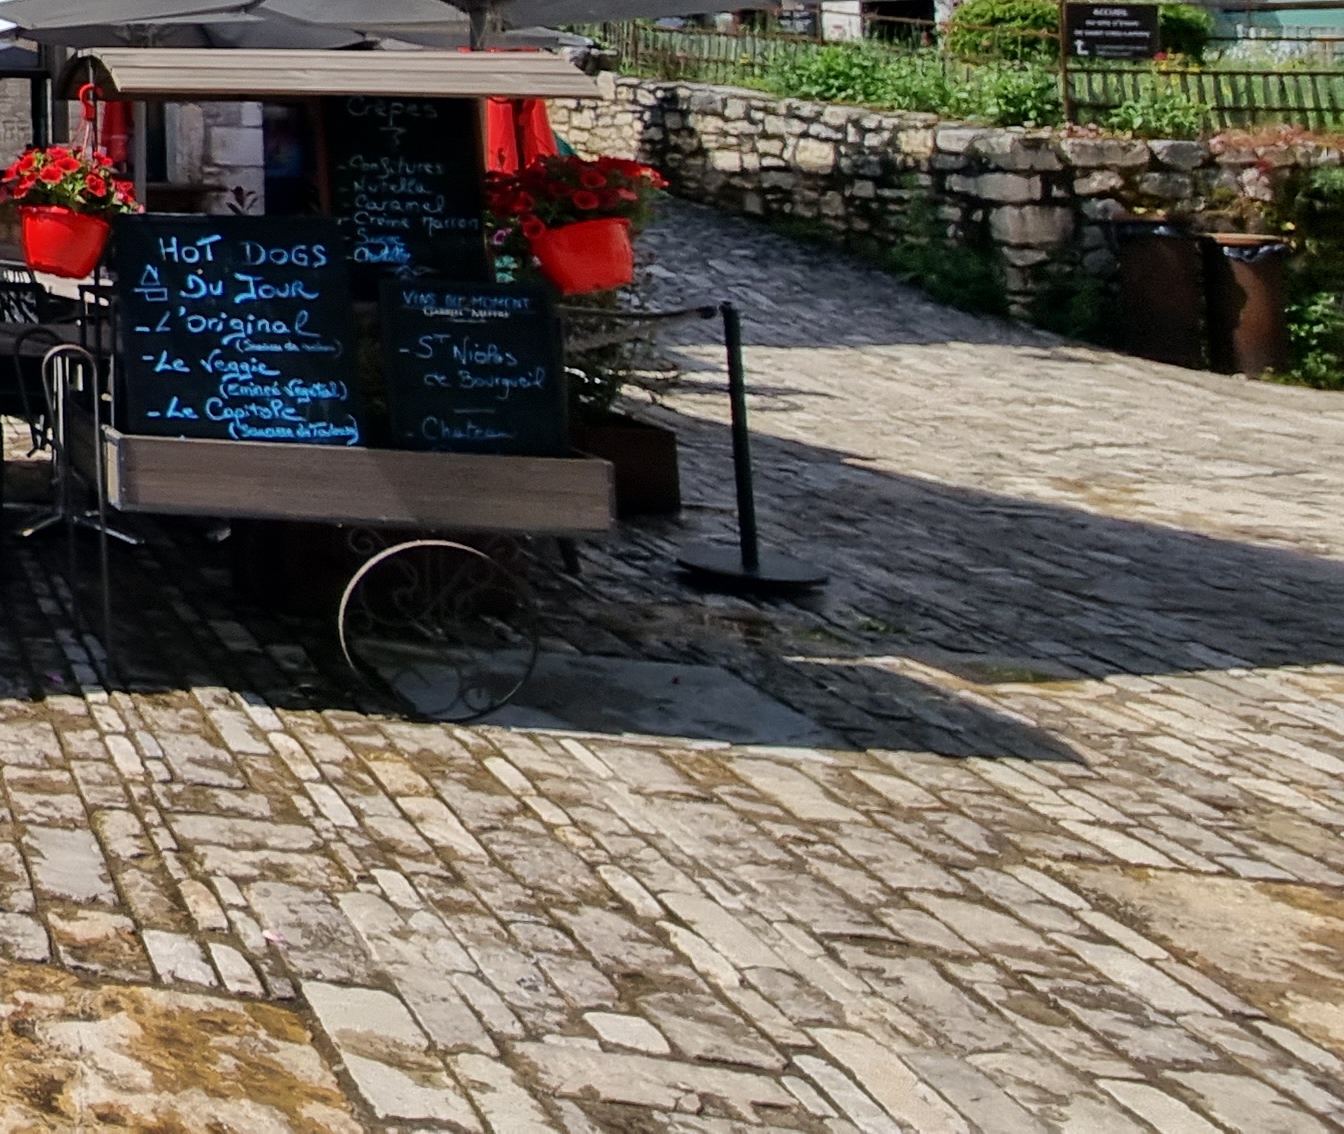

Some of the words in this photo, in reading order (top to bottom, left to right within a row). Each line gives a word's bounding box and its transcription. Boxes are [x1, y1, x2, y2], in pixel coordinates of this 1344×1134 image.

[355, 194, 445, 214] Caramel
[238, 241, 327, 268] DOGS
[166, 395, 200, 419] Le
